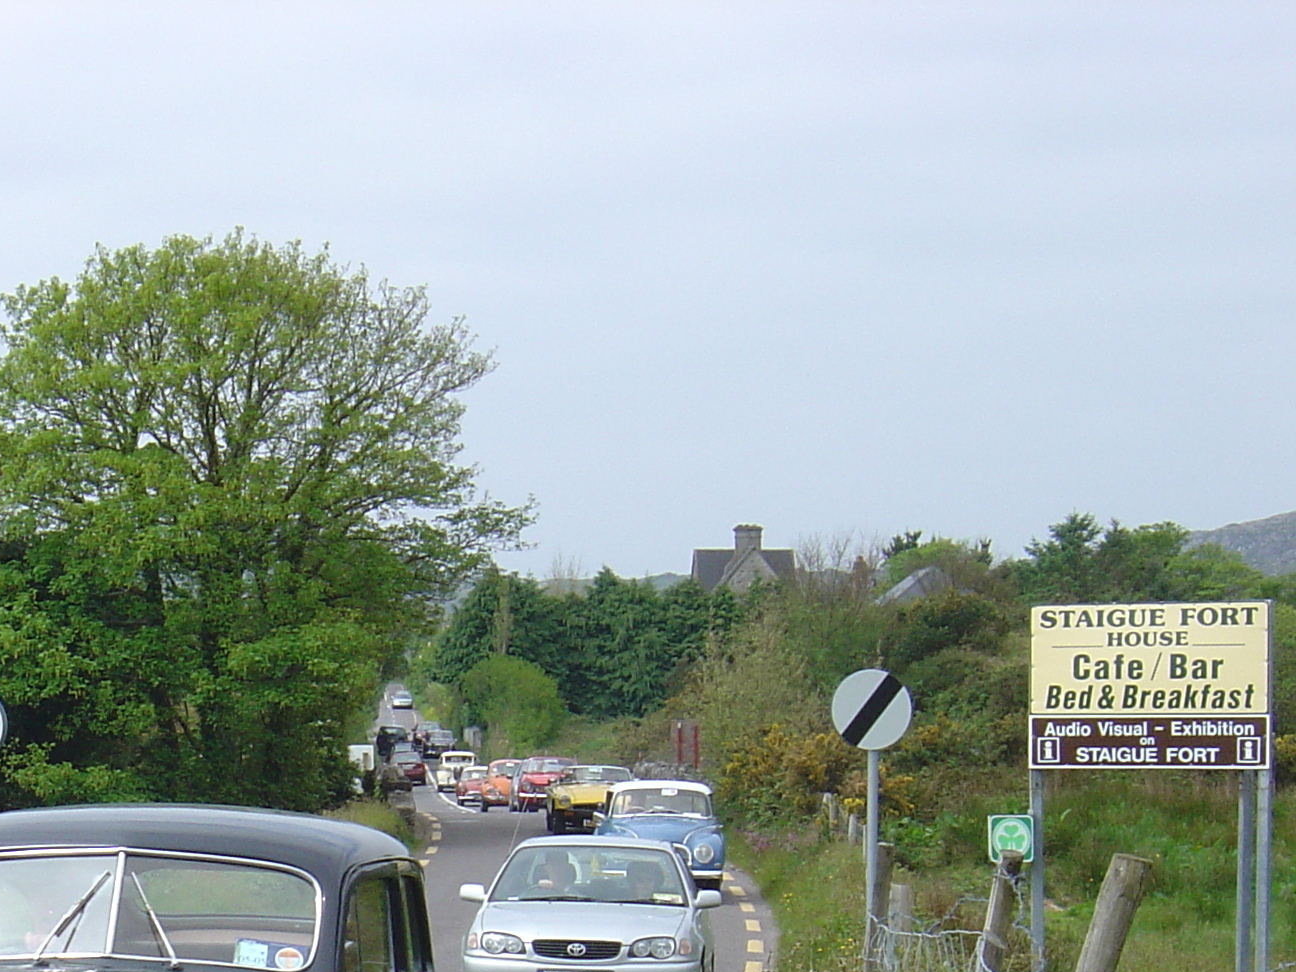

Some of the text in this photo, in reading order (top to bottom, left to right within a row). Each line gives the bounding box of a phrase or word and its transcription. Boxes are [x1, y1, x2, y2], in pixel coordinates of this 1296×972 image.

[1039, 607, 1258, 628] STAIGUE FORT
[1106, 631, 1189, 647] HOUSE
[1072, 653, 1144, 680] Cafe
[1169, 653, 1224, 680] Bar
[1044, 722, 1091, 738] Audio
[1098, 721, 1148, 737] Visual
[1170, 721, 1255, 737] Exhibition
[1139, 736, 1155, 746] on
[1075, 747, 1220, 763] STAIGUE FORT
